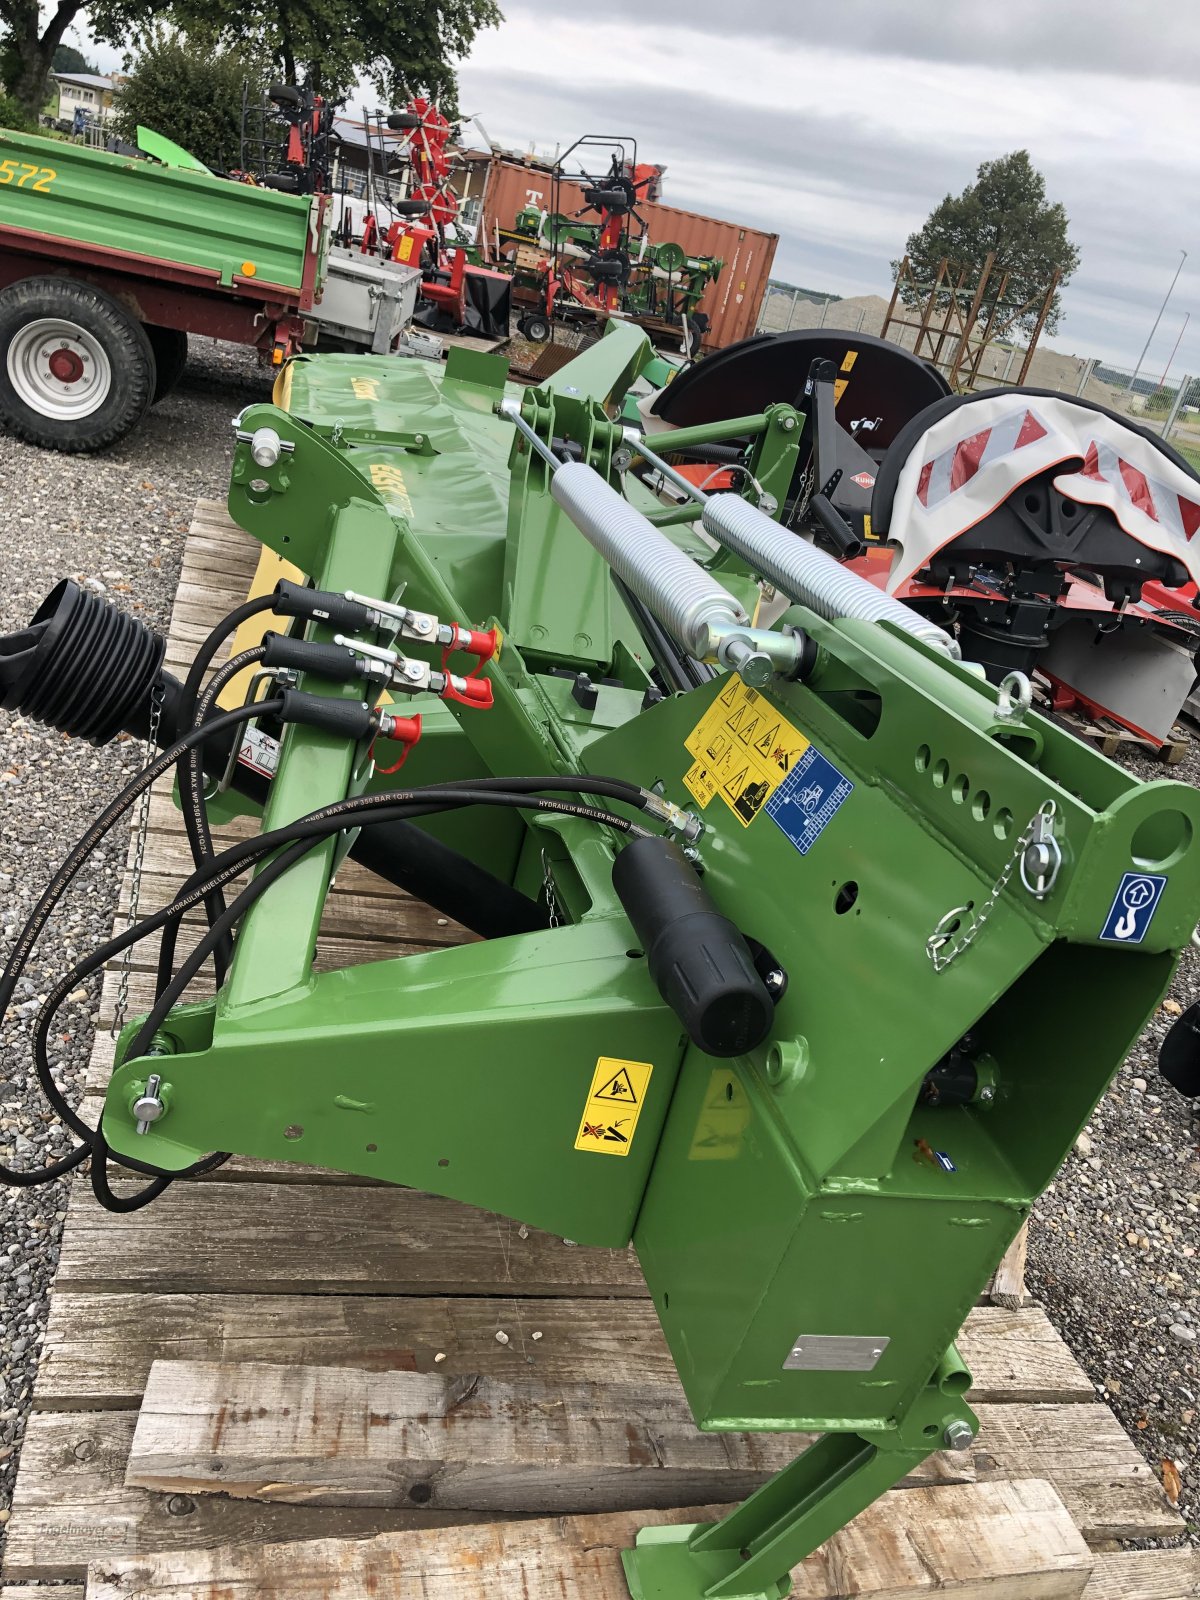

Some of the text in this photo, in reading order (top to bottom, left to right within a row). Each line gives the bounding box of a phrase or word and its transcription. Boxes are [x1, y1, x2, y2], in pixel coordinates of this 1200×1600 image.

[0, 160, 57, 193] 572
[855, 476, 875, 485] KUHN
[234, 646, 267, 666] MUELLER
[211, 664, 234, 688] RHEINE
[150, 743, 188, 777] HYDRAULIK
[124, 776, 152, 802] MUELLER
[190, 771, 198, 790] MAX.
[192, 791, 199, 803] WP
[346, 800, 359, 809] WP
[360, 797, 373, 805] 350
[374, 794, 391, 803] BAR
[102, 802, 125, 827] RHEINE
[192, 804, 201, 817] 350
[538, 800, 629, 829] HYDRAULIK MUELLER RHEINE
[195, 818, 204, 834] BAR
[166, 855, 254, 916] HYDRAULIK MUELLER RHEINE
[34, 916, 43, 928] WP
[26, 928, 37, 941] 350
[18, 941, 30, 957] BAR
